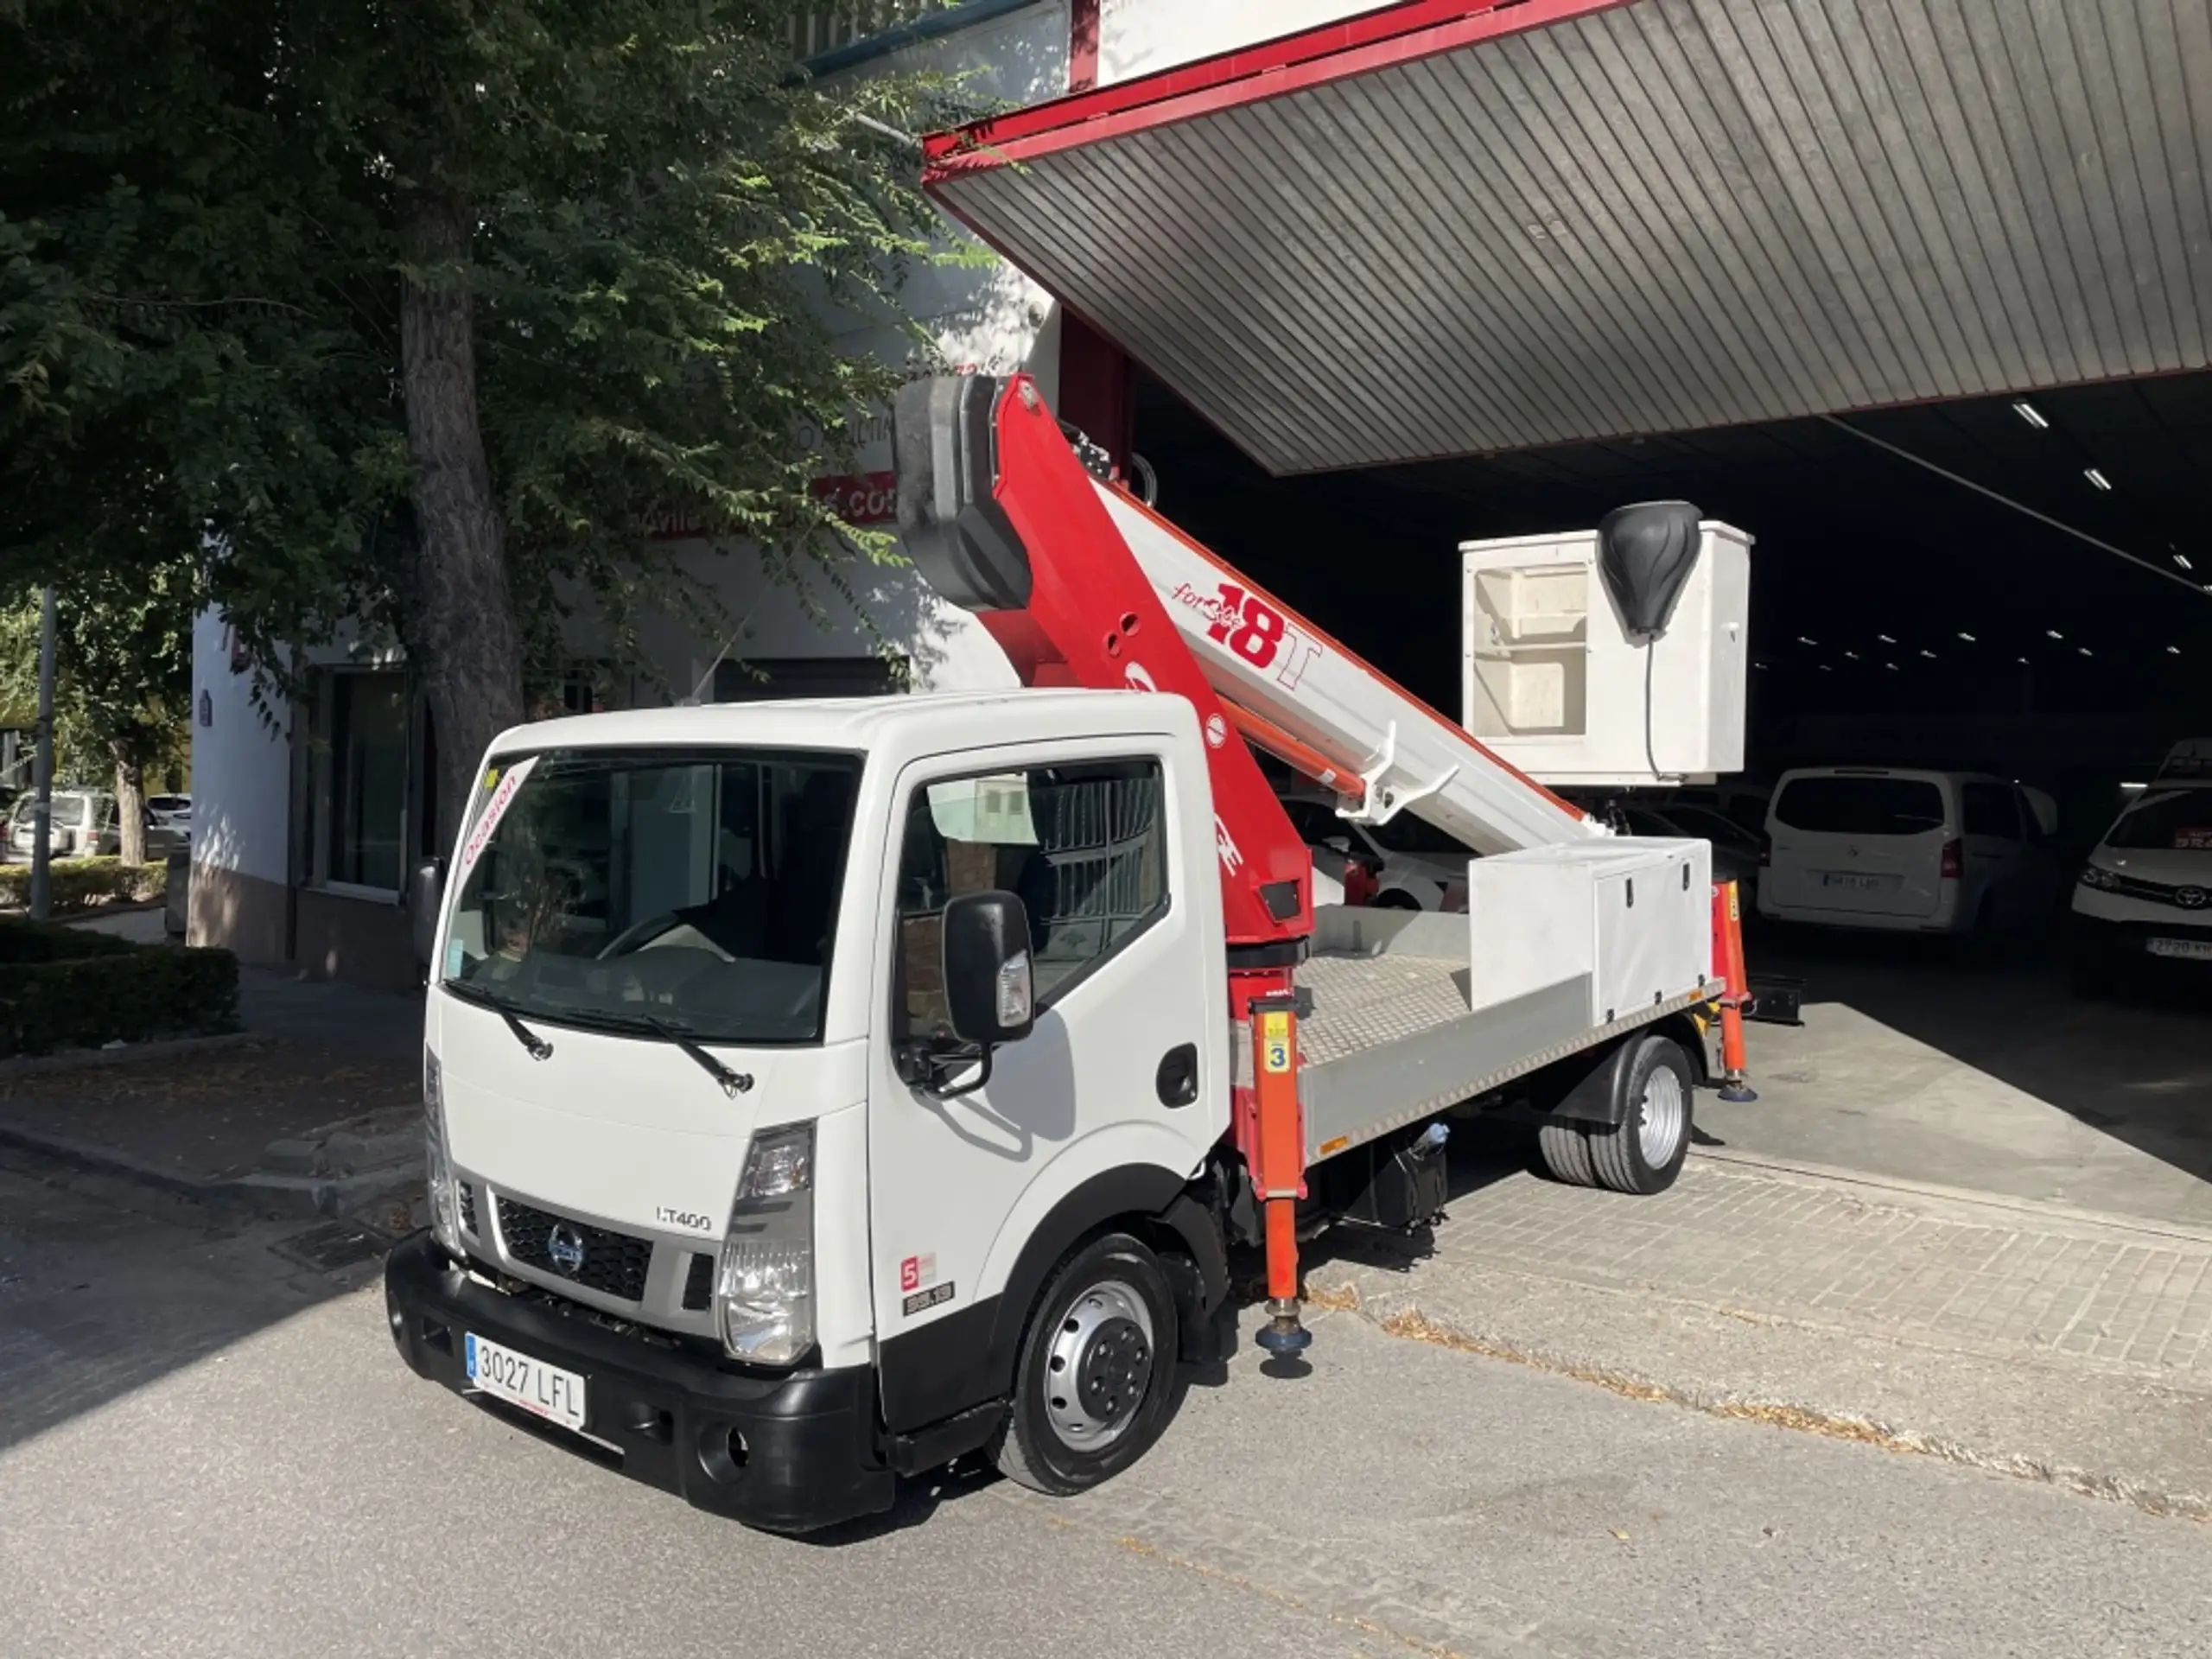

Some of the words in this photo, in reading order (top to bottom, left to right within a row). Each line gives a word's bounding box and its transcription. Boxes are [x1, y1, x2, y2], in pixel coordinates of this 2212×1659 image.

[1270, 1047, 1286, 1068] 3
[904, 1262, 917, 1287] 5
[480, 1346, 529, 1394] 3027
[537, 1367, 581, 1417] LFL
